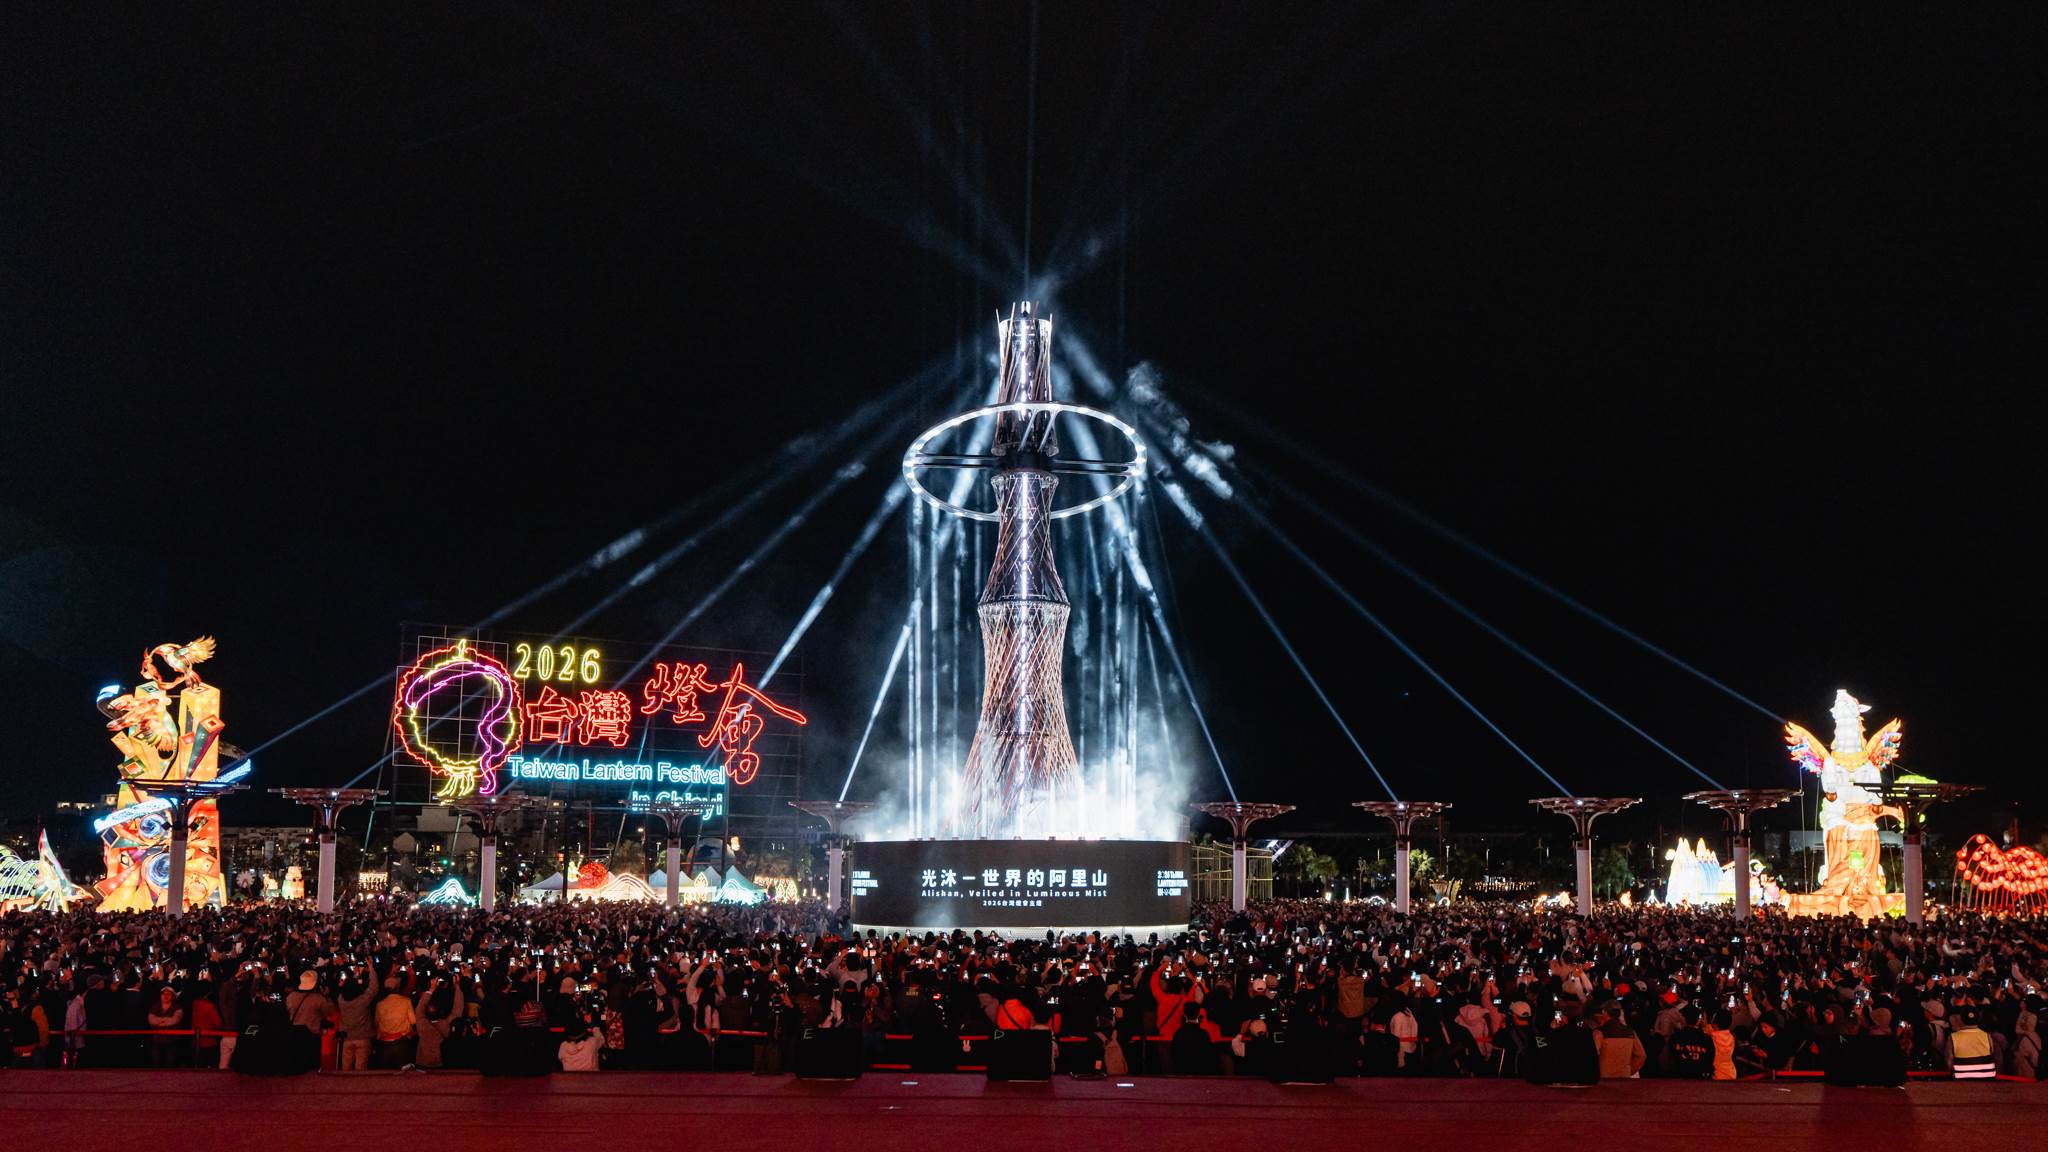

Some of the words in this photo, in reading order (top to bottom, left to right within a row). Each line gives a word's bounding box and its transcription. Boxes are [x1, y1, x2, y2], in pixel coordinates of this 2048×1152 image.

[514, 643, 600, 683] 2026
[508, 756, 579, 780] Taiwan
[582, 759, 651, 781] Lantern
[657, 761, 726, 785] Festival
[921, 889, 964, 899] Alishan,
[969, 889, 1005, 897] Veiled
[1010, 889, 1021, 897] in
[1026, 889, 1080, 897] Luminous
[1085, 889, 1107, 897] Mist
[803, 1028, 814, 1039] E
